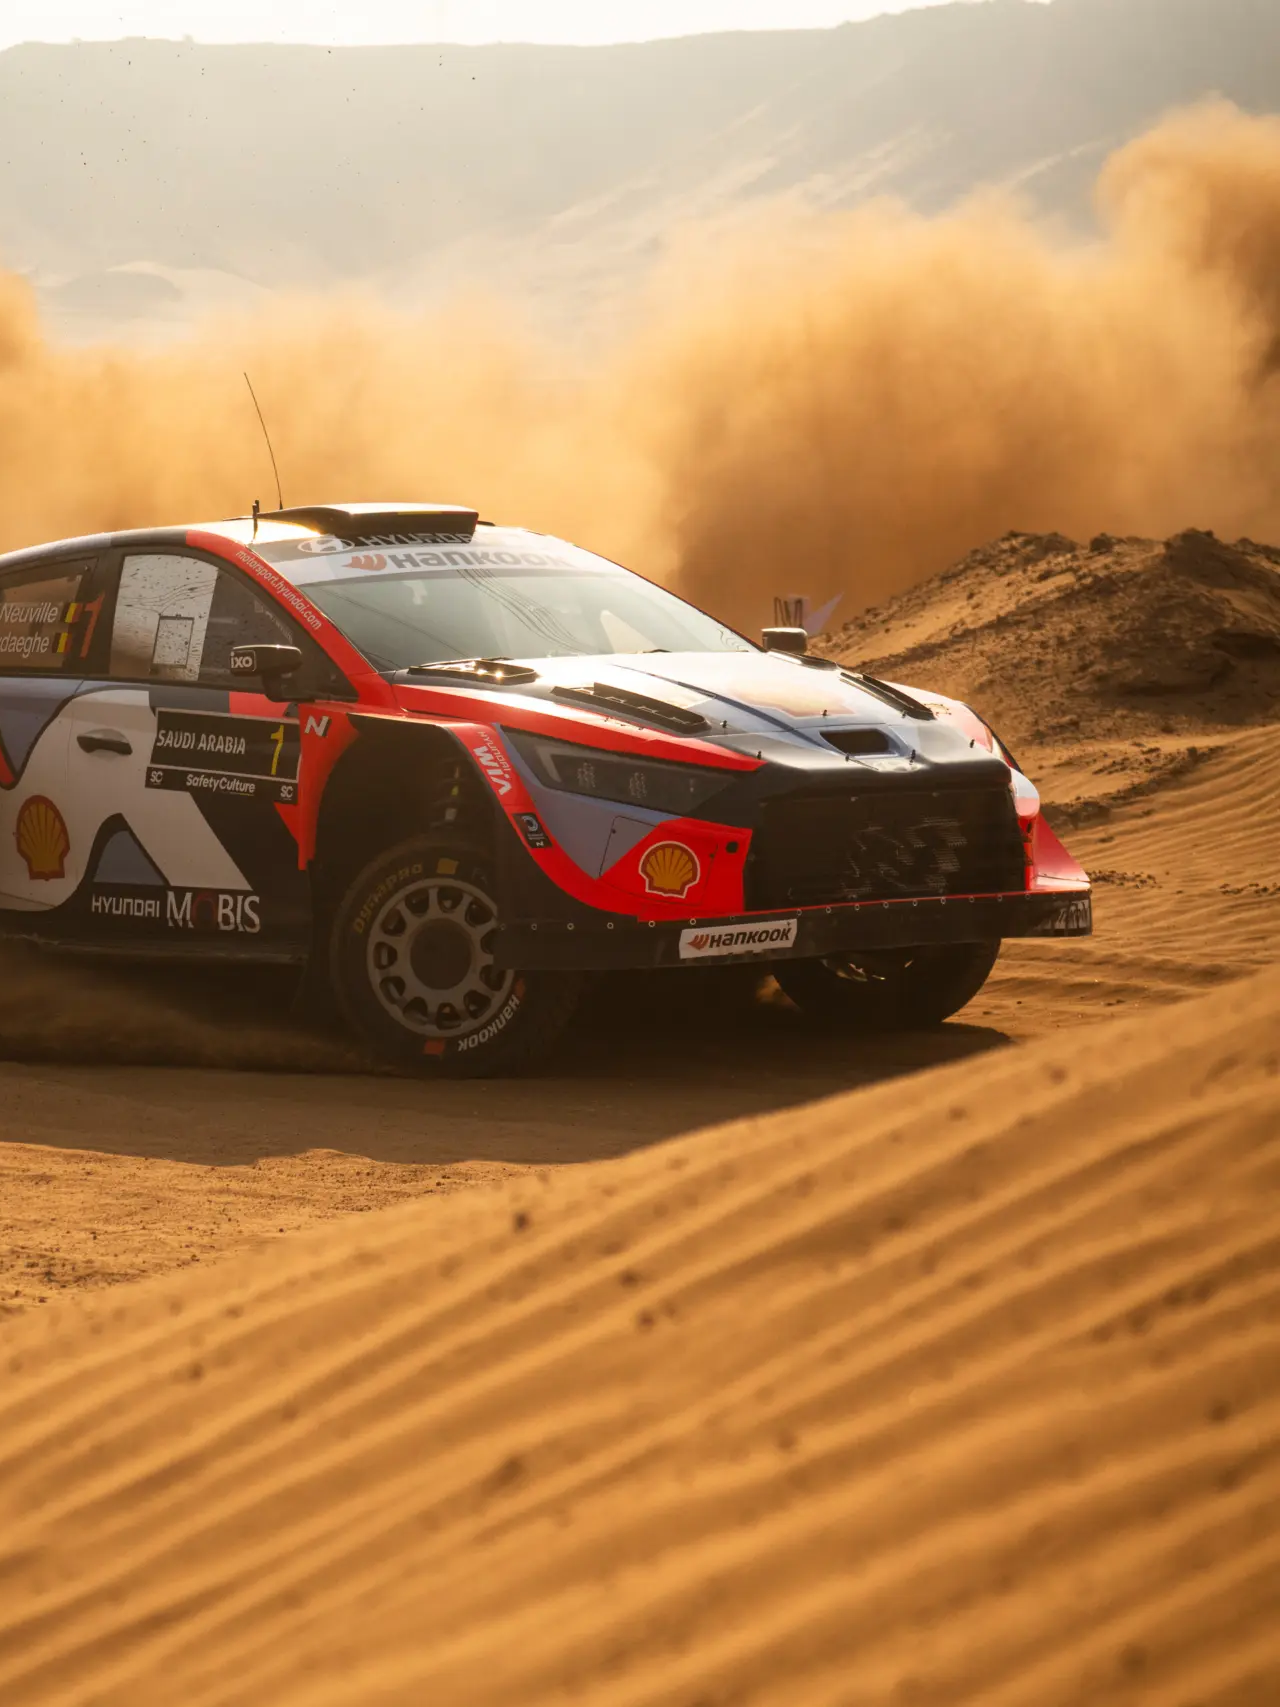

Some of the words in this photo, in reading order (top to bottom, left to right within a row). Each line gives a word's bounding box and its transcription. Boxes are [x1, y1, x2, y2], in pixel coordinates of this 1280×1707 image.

[358, 533, 475, 546] HYUNDA
[235, 550, 322, 631] motorsport.hyundai.com
[79, 591, 106, 659] 1
[304, 715, 330, 737] N
[156, 730, 196, 750] SAUDI
[196, 733, 246, 755] ARABIA
[270, 725, 284, 775] 1
[150, 771, 163, 783] SC
[186, 774, 256, 793] SafetyCulture
[280, 785, 293, 798] SC
[92, 894, 160, 918] HYUNDAI
[166, 890, 261, 933] MOBIS
